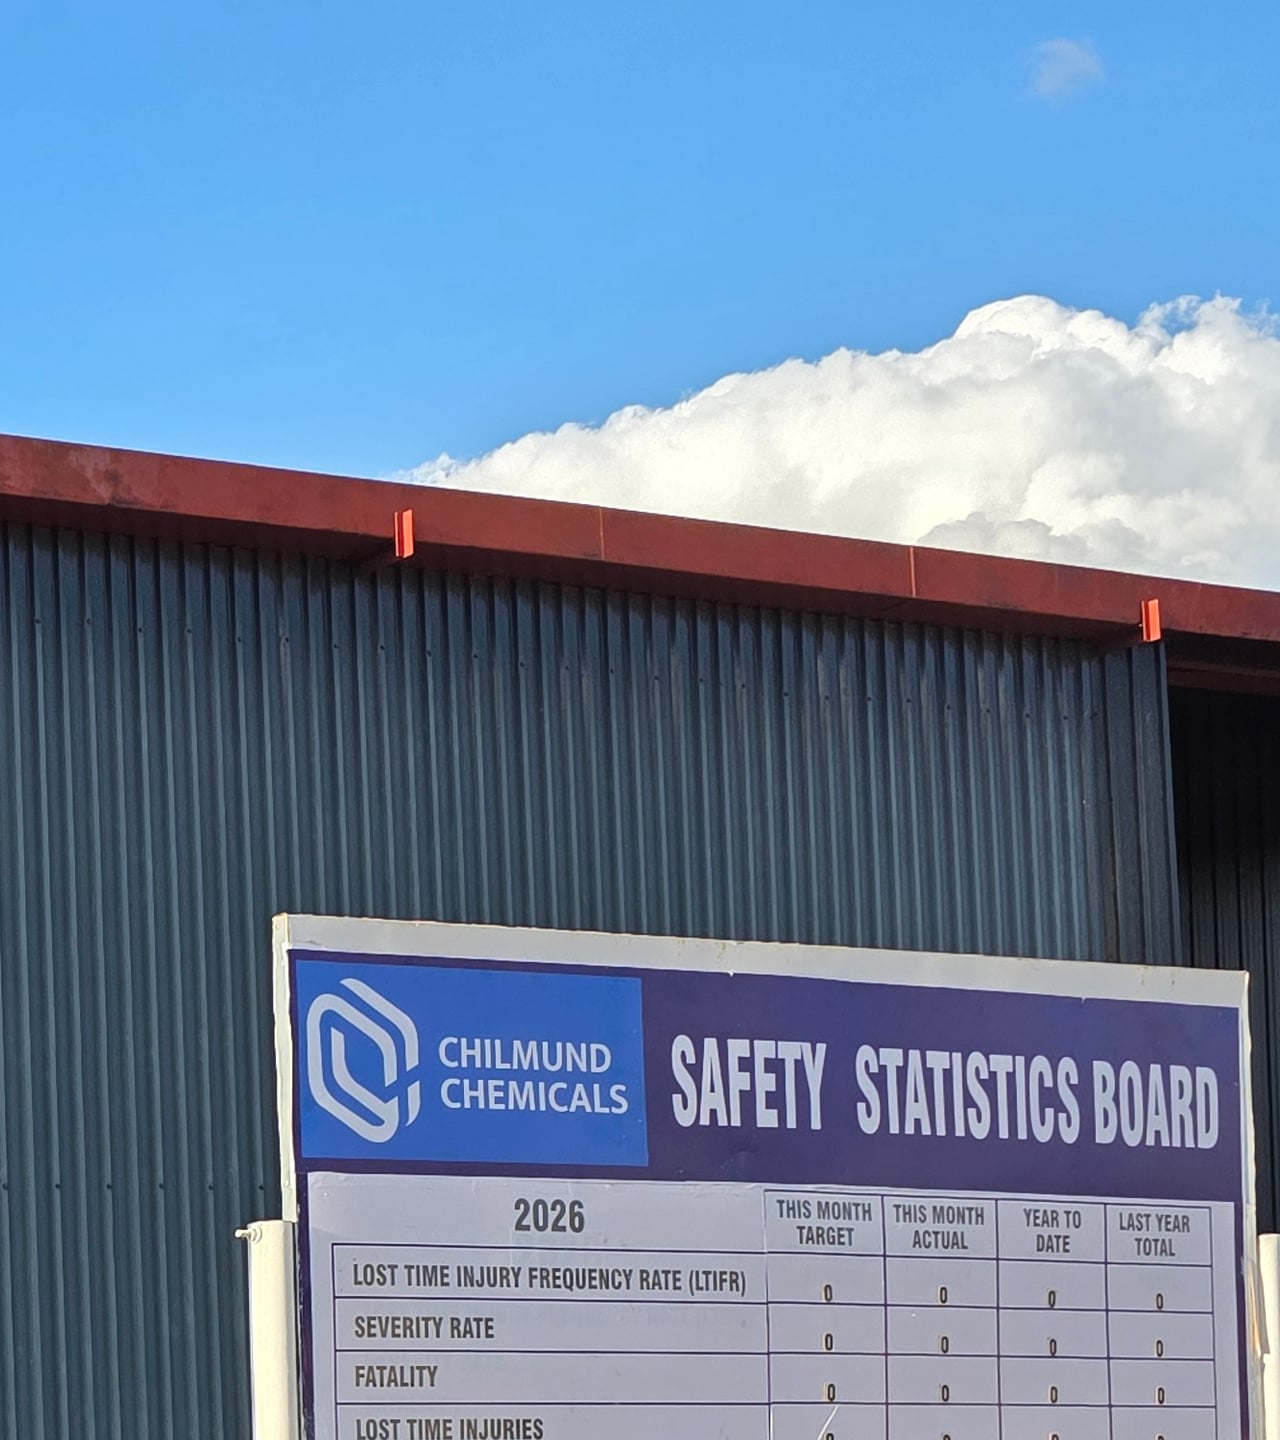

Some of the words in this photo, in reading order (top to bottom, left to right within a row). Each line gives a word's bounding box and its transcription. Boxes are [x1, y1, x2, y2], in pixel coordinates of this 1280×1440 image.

[439, 1037, 610, 1072] CHILMUND
[441, 1078, 628, 1114] CHEMICALS
[672, 1035, 826, 1130] SAFETY
[856, 1045, 1080, 1144] STATISTICS
[1093, 1061, 1218, 1148] BOARD
[515, 1198, 584, 1233] 2026
[776, 1200, 811, 1218] THIS
[817, 1201, 872, 1221] MONTH
[893, 1204, 926, 1223] THIS
[932, 1206, 984, 1225] MONTH
[1024, 1208, 1059, 1228] YEAR
[1064, 1210, 1081, 1228] TO
[1120, 1212, 1151, 1231] LAST
[1156, 1214, 1190, 1232] YEAR
[796, 1226, 854, 1246] TARGET
[913, 1230, 968, 1249] ACTUAL
[1037, 1234, 1070, 1253] DATE
[1134, 1238, 1175, 1256] TOTAL
[354, 1264, 398, 1286] LOST
[404, 1265, 450, 1286] TIME
[457, 1266, 521, 1288] INJURY
[529, 1268, 632, 1291] FREQUENCY
[640, 1270, 682, 1290] RATE
[689, 1270, 745, 1296] (LTIFR)
[355, 1316, 443, 1338] SEVERITY
[450, 1317, 494, 1338] RATE
[356, 1366, 438, 1387] FATALITY
[356, 1419, 400, 1440] LOST
[407, 1419, 452, 1440] TIME
[460, 1418, 543, 1440] INJURIES
